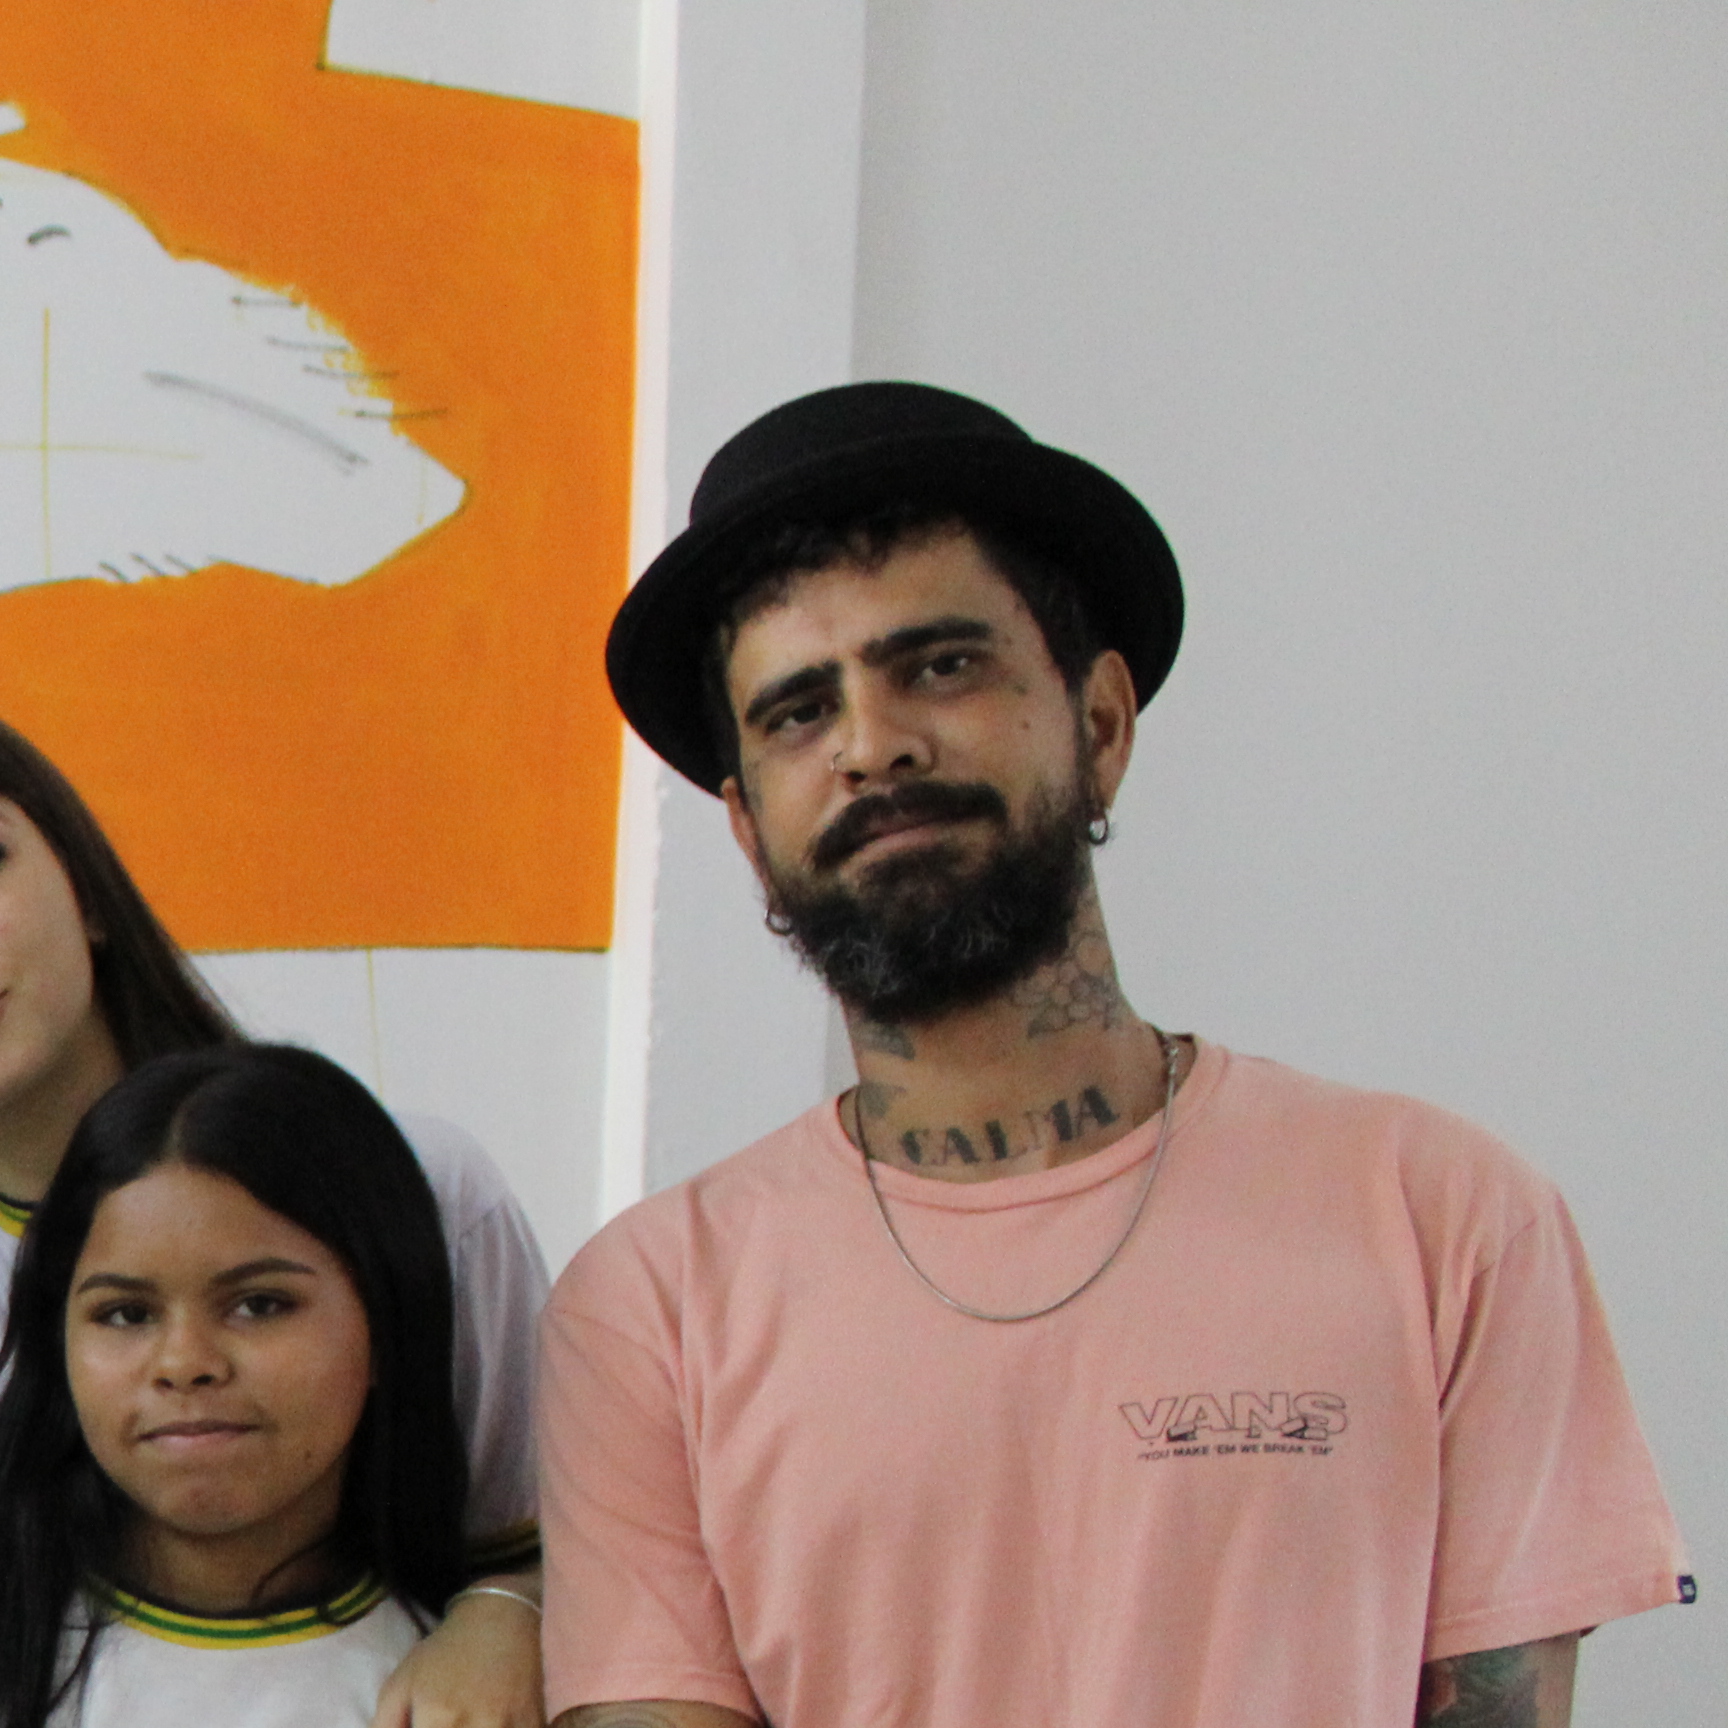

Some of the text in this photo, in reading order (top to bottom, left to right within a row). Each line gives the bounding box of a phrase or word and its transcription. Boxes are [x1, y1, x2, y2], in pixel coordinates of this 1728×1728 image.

[1119, 1391, 1347, 1441] VANS
[1173, 1445, 1209, 1457] MAKE
[1241, 1443, 1260, 1454] WE
